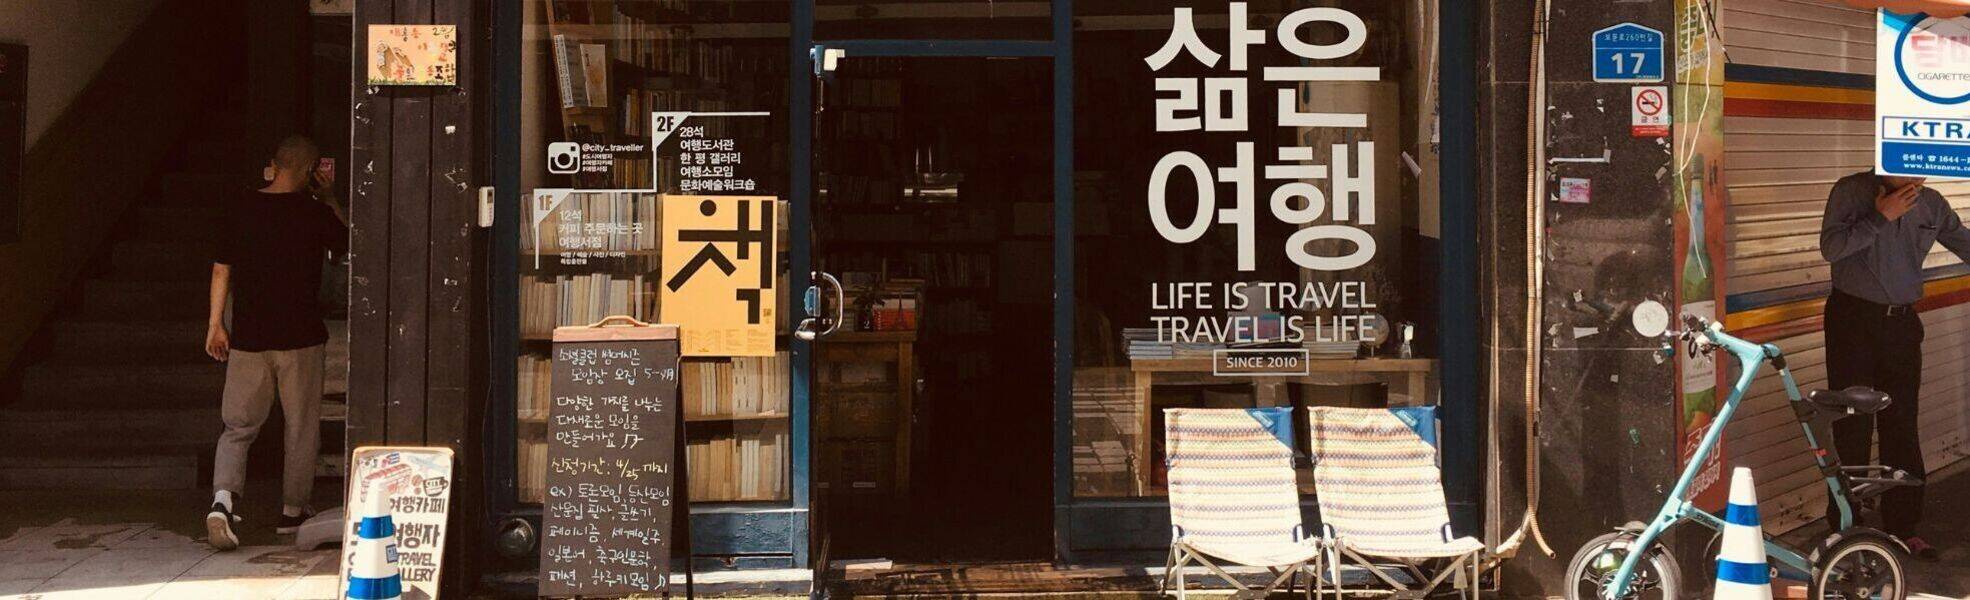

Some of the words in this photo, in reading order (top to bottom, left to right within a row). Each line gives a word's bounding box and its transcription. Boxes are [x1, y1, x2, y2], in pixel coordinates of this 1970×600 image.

[1144, 1, 1381, 132] 삶은
[1610, 52, 1645, 74] 17
[657, 116, 674, 132] 2F
[680, 126, 704, 137] 28석
[1902, 121, 1970, 139] KTR
[582, 143, 643, 153] @city_traveller
[680, 139, 734, 151] 여행도서관
[680, 153, 692, 164] 한
[695, 153, 706, 164] 평
[710, 152, 741, 164] 갤러리
[680, 166, 734, 177] 여행소모임
[538, 194, 553, 210] 1F
[1147, 140, 1377, 271] 여행
[559, 210, 582, 222] 12석
[559, 223, 580, 234] 커피
[584, 223, 628, 234] 주문하는
[632, 222, 644, 234] 곳
[559, 236, 602, 248] 여행서점
[666, 200, 773, 324] 책
[1152, 282, 1212, 310] LIFE
[1224, 282, 1248, 310] IS
[1258, 281, 1377, 309] TRAVEL
[1151, 315, 1274, 343] TRAVEL
[1280, 314, 1304, 343] IS
[1316, 314, 1376, 342] LIFE
[1226, 356, 1264, 369] SINCE
[1267, 356, 1298, 369] 2010
[615, 368, 637, 385] 모집
[557, 395, 594, 411] 다양한
[601, 396, 629, 412] 가치를
[635, 396, 663, 412] 나누는
[609, 414, 640, 430] 모임을
[556, 430, 616, 448] 만들어가요
[642, 460, 668, 474] 까지
